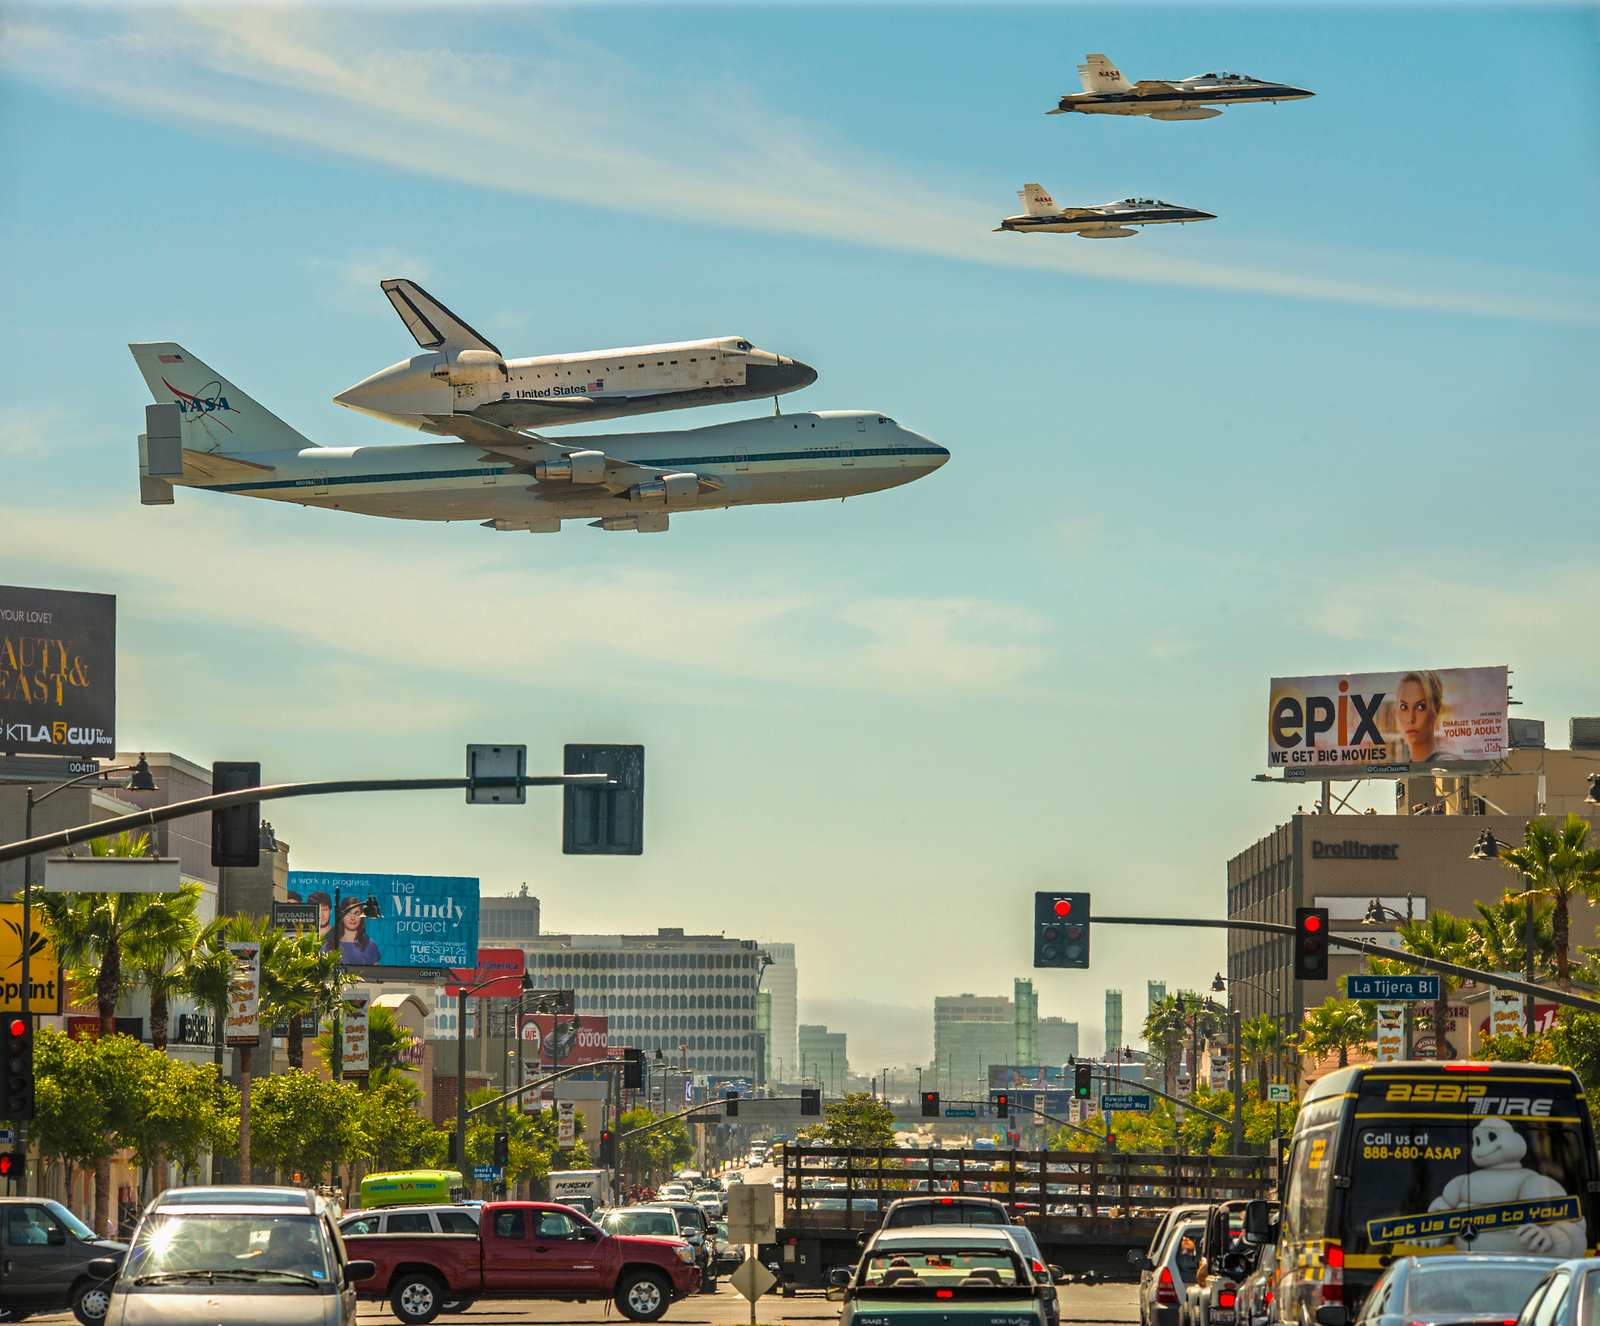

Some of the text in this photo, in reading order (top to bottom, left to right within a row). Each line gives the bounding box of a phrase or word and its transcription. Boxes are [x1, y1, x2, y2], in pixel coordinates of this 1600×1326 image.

[516, 385, 587, 398] United States
[174, 397, 230, 413] NASA
[0, 609, 52, 624] YOUR LOVE?
[68, 655, 90, 687] &
[1272, 680, 1386, 748] epix
[6, 723, 52, 742] KTLA
[53, 721, 68, 745] 5
[1444, 725, 1502, 738] YOUNG ADULT
[96, 736, 113, 744] NOW
[1484, 742, 1501, 753] dish
[1271, 748, 1387, 764] WE GET BIG MOVIES
[1312, 840, 1400, 859] Drollinger
[390, 880, 414, 894] the
[390, 894, 468, 928] Mindy
[396, 918, 446, 936] project
[410, 946, 466, 956] TUE SEPT 25
[439, 956, 457, 964] FOX
[458, 956, 466, 964] 11
[1354, 980, 1370, 993] La
[1374, 980, 1413, 996] Tijera
[238, 1002, 246, 1012] &
[227, 1012, 258, 1027] Enjoy!
[1494, 1010, 1520, 1022] Shop,
[345, 1024, 366, 1034] Shop,
[346, 1035, 364, 1044] Dine
[1380, 1036, 1401, 1045] Shop,
[344, 1050, 368, 1063] Enjoy!
[1382, 1046, 1399, 1055] Dine
[1468, 1097, 1554, 1116] TIRE
[1363, 1132, 1429, 1146] Call us at
[1363, 1146, 1462, 1160] 888-680-ASAP
[1381, 1224, 1416, 1238] Let
[1420, 1220, 1444, 1232] Us
[1501, 1210, 1524, 1222] to
[1529, 1204, 1569, 1219] You!
